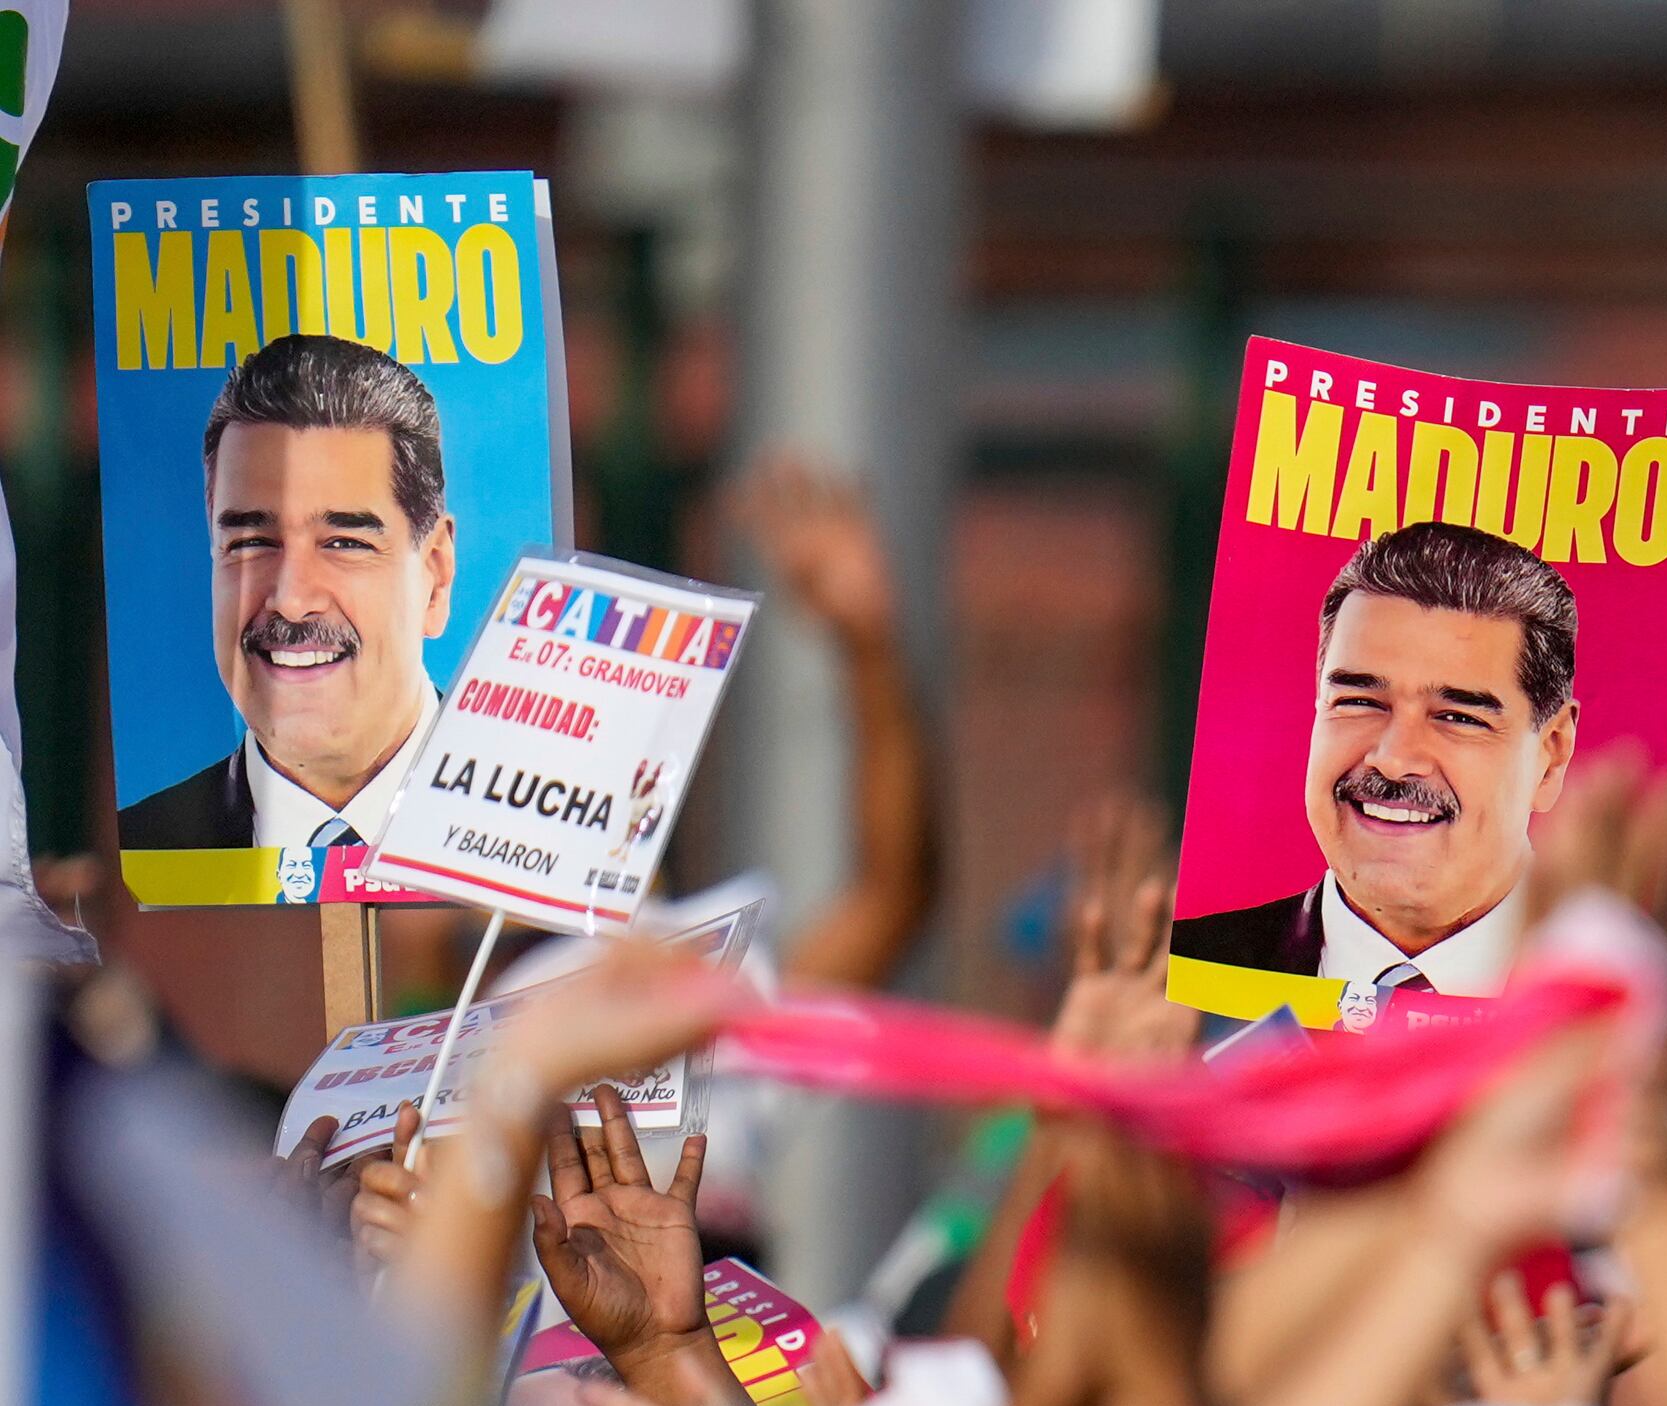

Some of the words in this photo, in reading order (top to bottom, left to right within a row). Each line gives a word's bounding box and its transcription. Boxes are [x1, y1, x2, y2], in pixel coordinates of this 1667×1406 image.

[111, 193, 509, 229] PRESIDENTE
[114, 224, 523, 370] MADURO
[526, 581, 709, 667] CATIA
[537, 639, 572, 672] 07:
[578, 655, 691, 699] GRAMOVEN
[457, 677, 600, 743] COMUNIDAD:
[431, 752, 477, 796] LA
[484, 764, 613, 831] LUCHA
[443, 824, 461, 848] Y
[458, 829, 559, 876] BAJARON
[703, 1269, 807, 1352] PRESID
